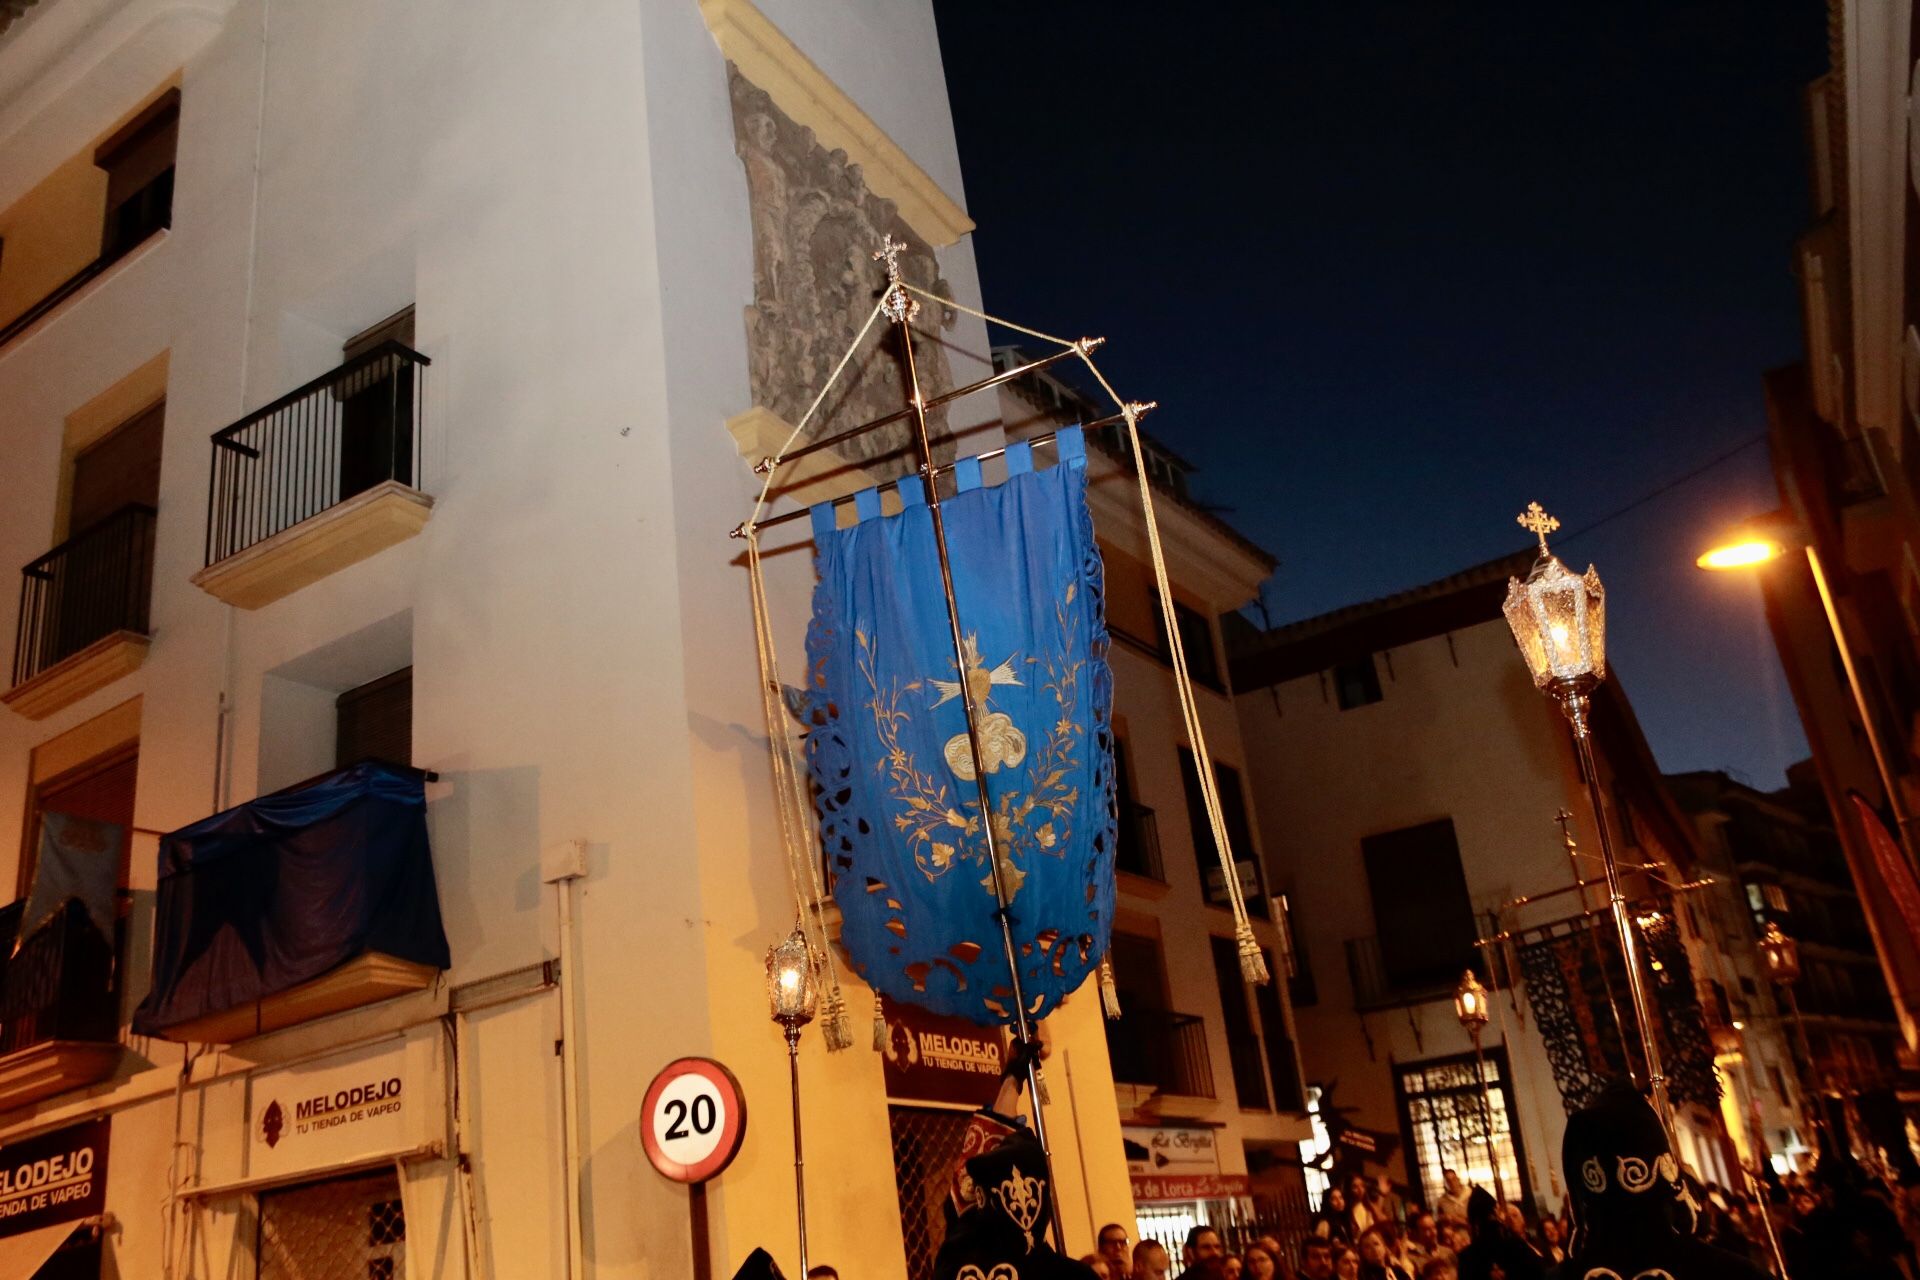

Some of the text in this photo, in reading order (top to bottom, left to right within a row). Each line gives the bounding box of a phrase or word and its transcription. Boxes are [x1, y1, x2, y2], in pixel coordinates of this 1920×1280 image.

[919, 1032, 999, 1060] MELODEJO
[922, 1056, 1002, 1076] TU TIENDA DE VAPEO
[296, 1078, 402, 1120] MELODEJO
[296, 1101, 402, 1135] TU TIENDA DE VAPEO
[663, 1094, 717, 1141] 20
[31, 1193, 48, 1211] DE
[51, 1182, 91, 1205] VAPEO
